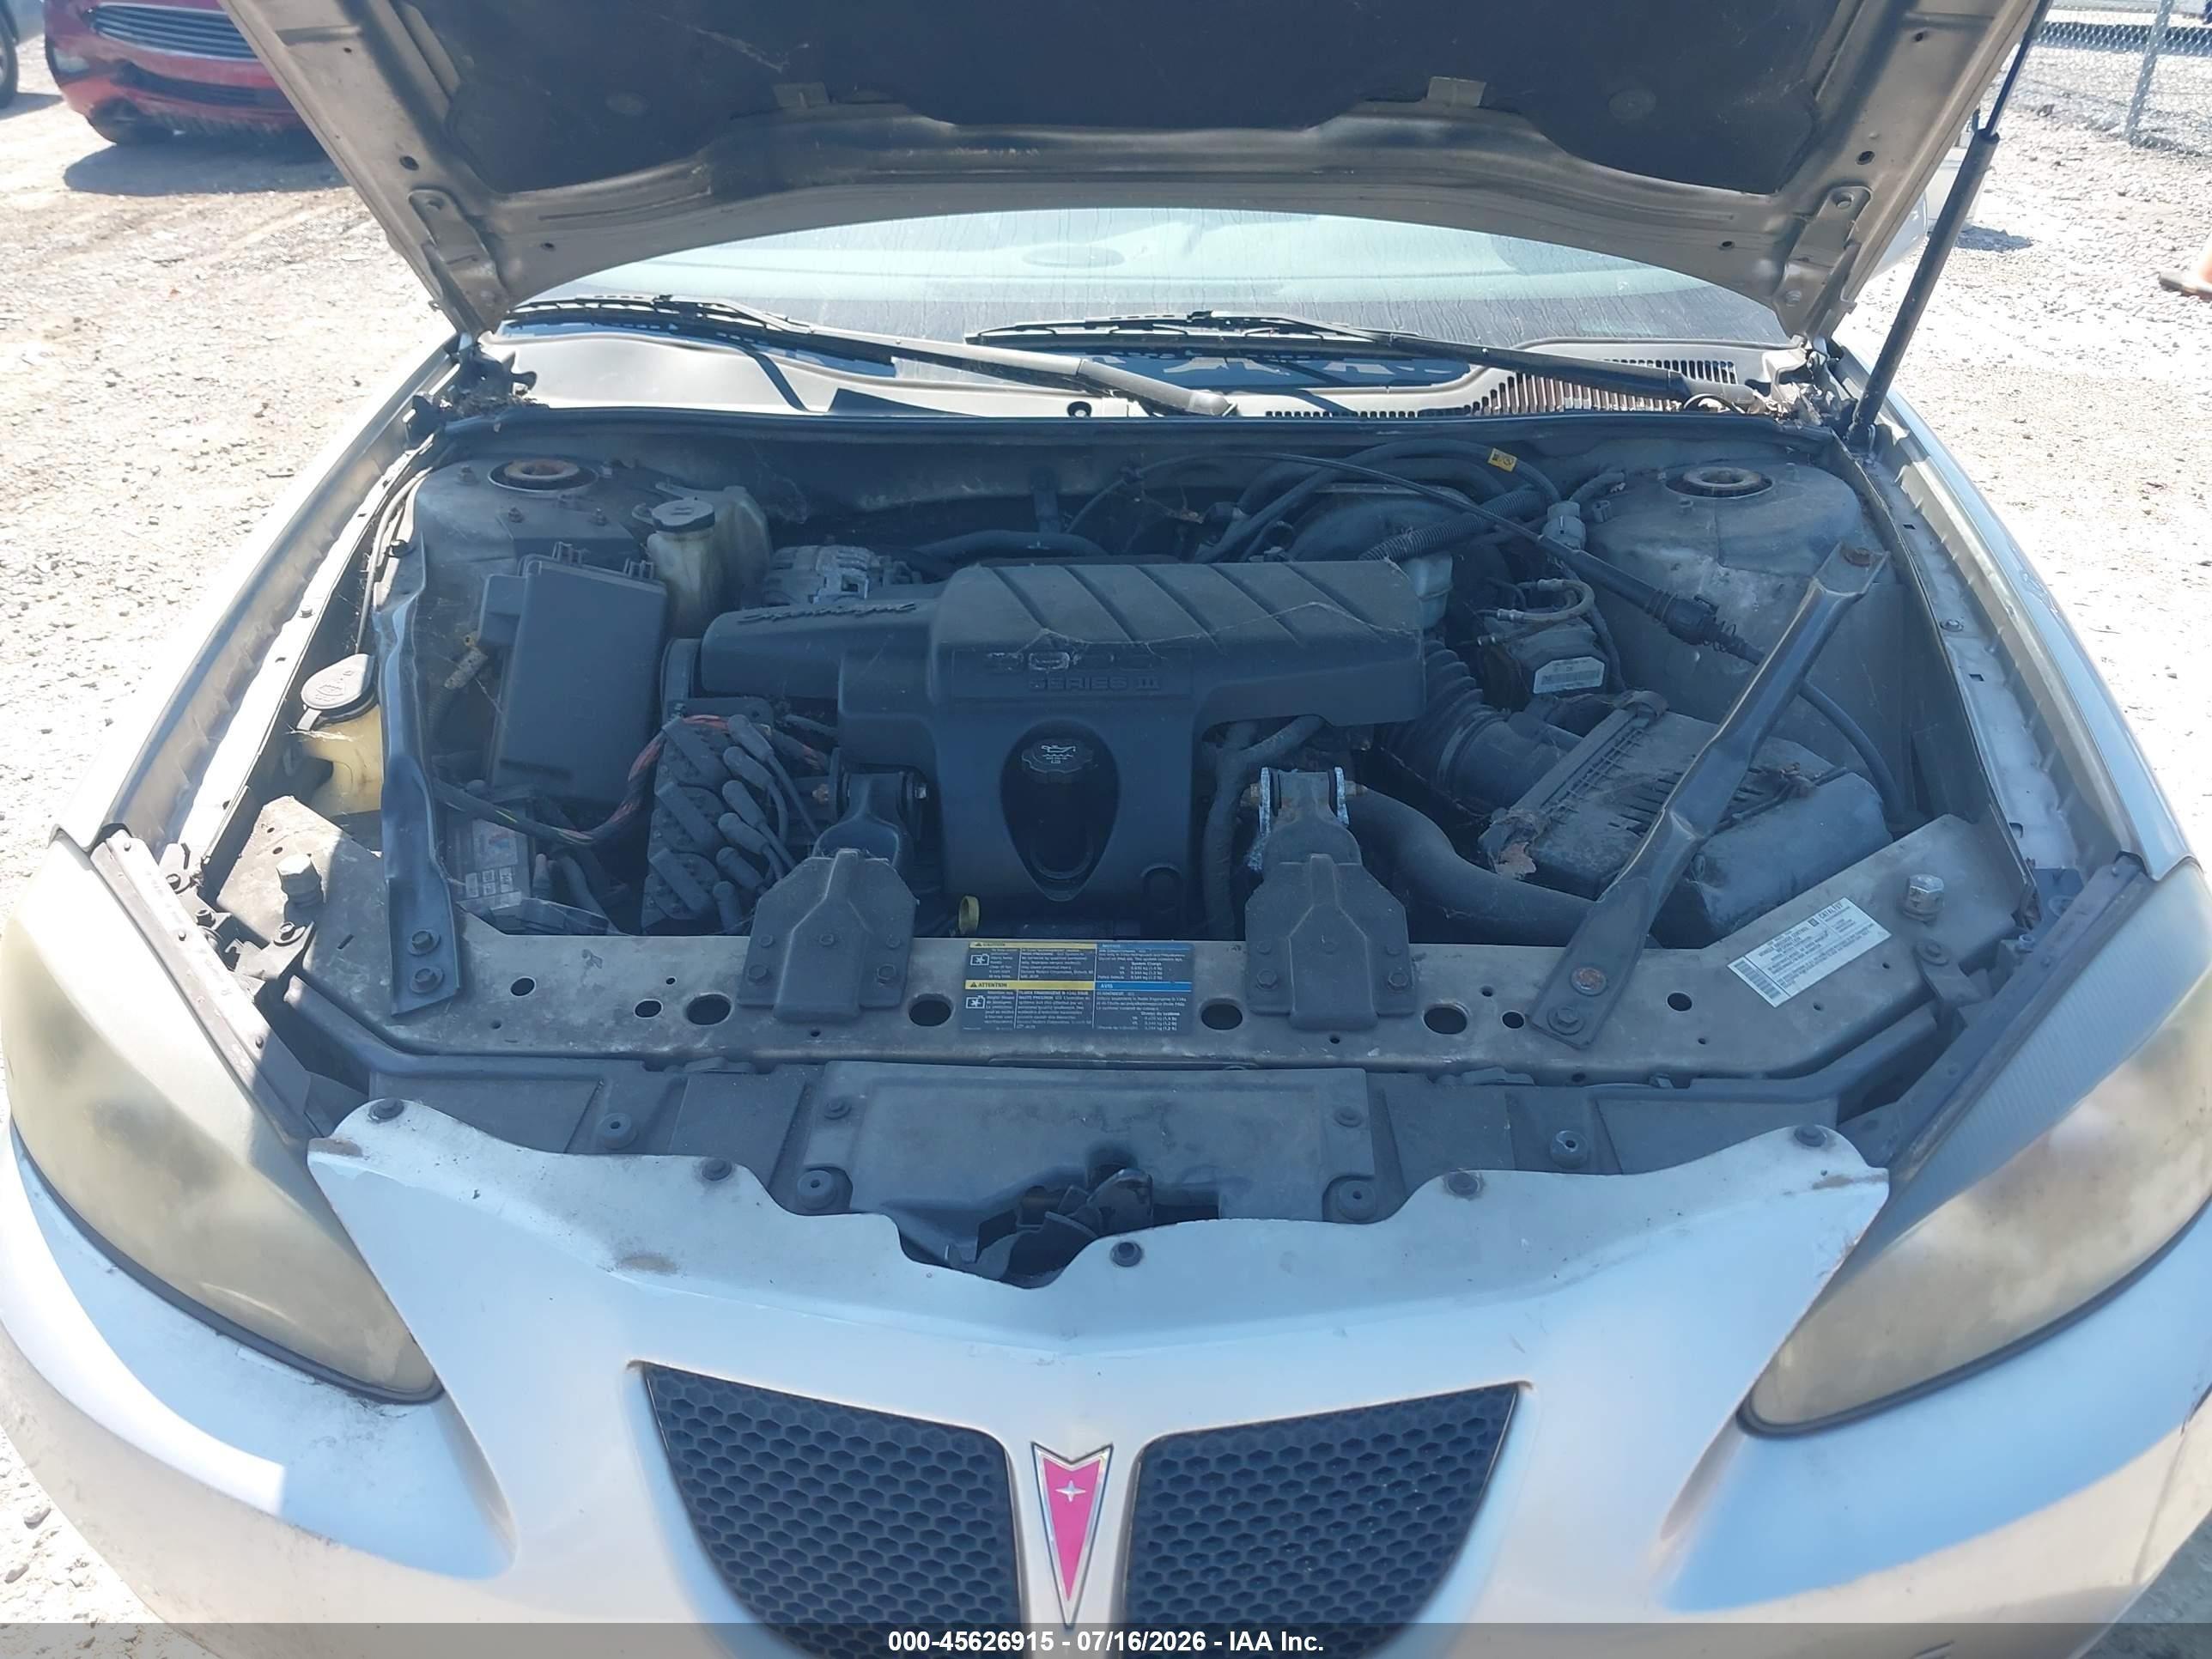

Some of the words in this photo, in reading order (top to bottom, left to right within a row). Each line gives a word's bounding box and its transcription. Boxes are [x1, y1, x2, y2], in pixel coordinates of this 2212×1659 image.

[1028, 676, 1127, 690] SERIES
[1136, 676, 1160, 690] III
[1818, 902, 1844, 919] CATALYST
